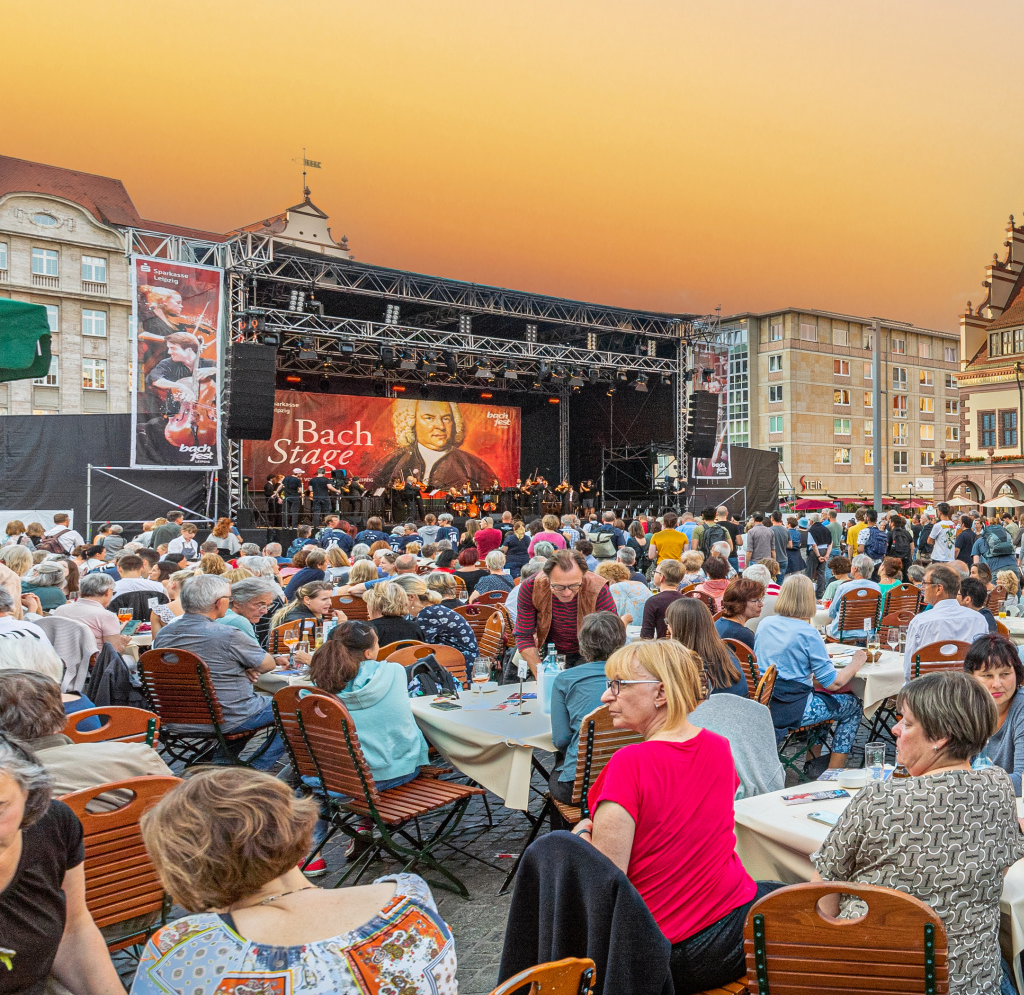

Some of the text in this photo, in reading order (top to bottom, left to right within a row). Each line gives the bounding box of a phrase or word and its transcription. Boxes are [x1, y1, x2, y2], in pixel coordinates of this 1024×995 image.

[154, 268, 188, 278] Sparkasse
[154, 276, 178, 285] Leipzig
[486, 411, 508, 419] bach
[494, 418, 511, 426] fest
[295, 418, 374, 446] Bach
[179, 444, 212, 453] bach
[190, 452, 214, 462] fest
[268, 438, 354, 474] Stage
[800, 475, 823, 492] STEIN
[450, 534, 457, 542] 14
